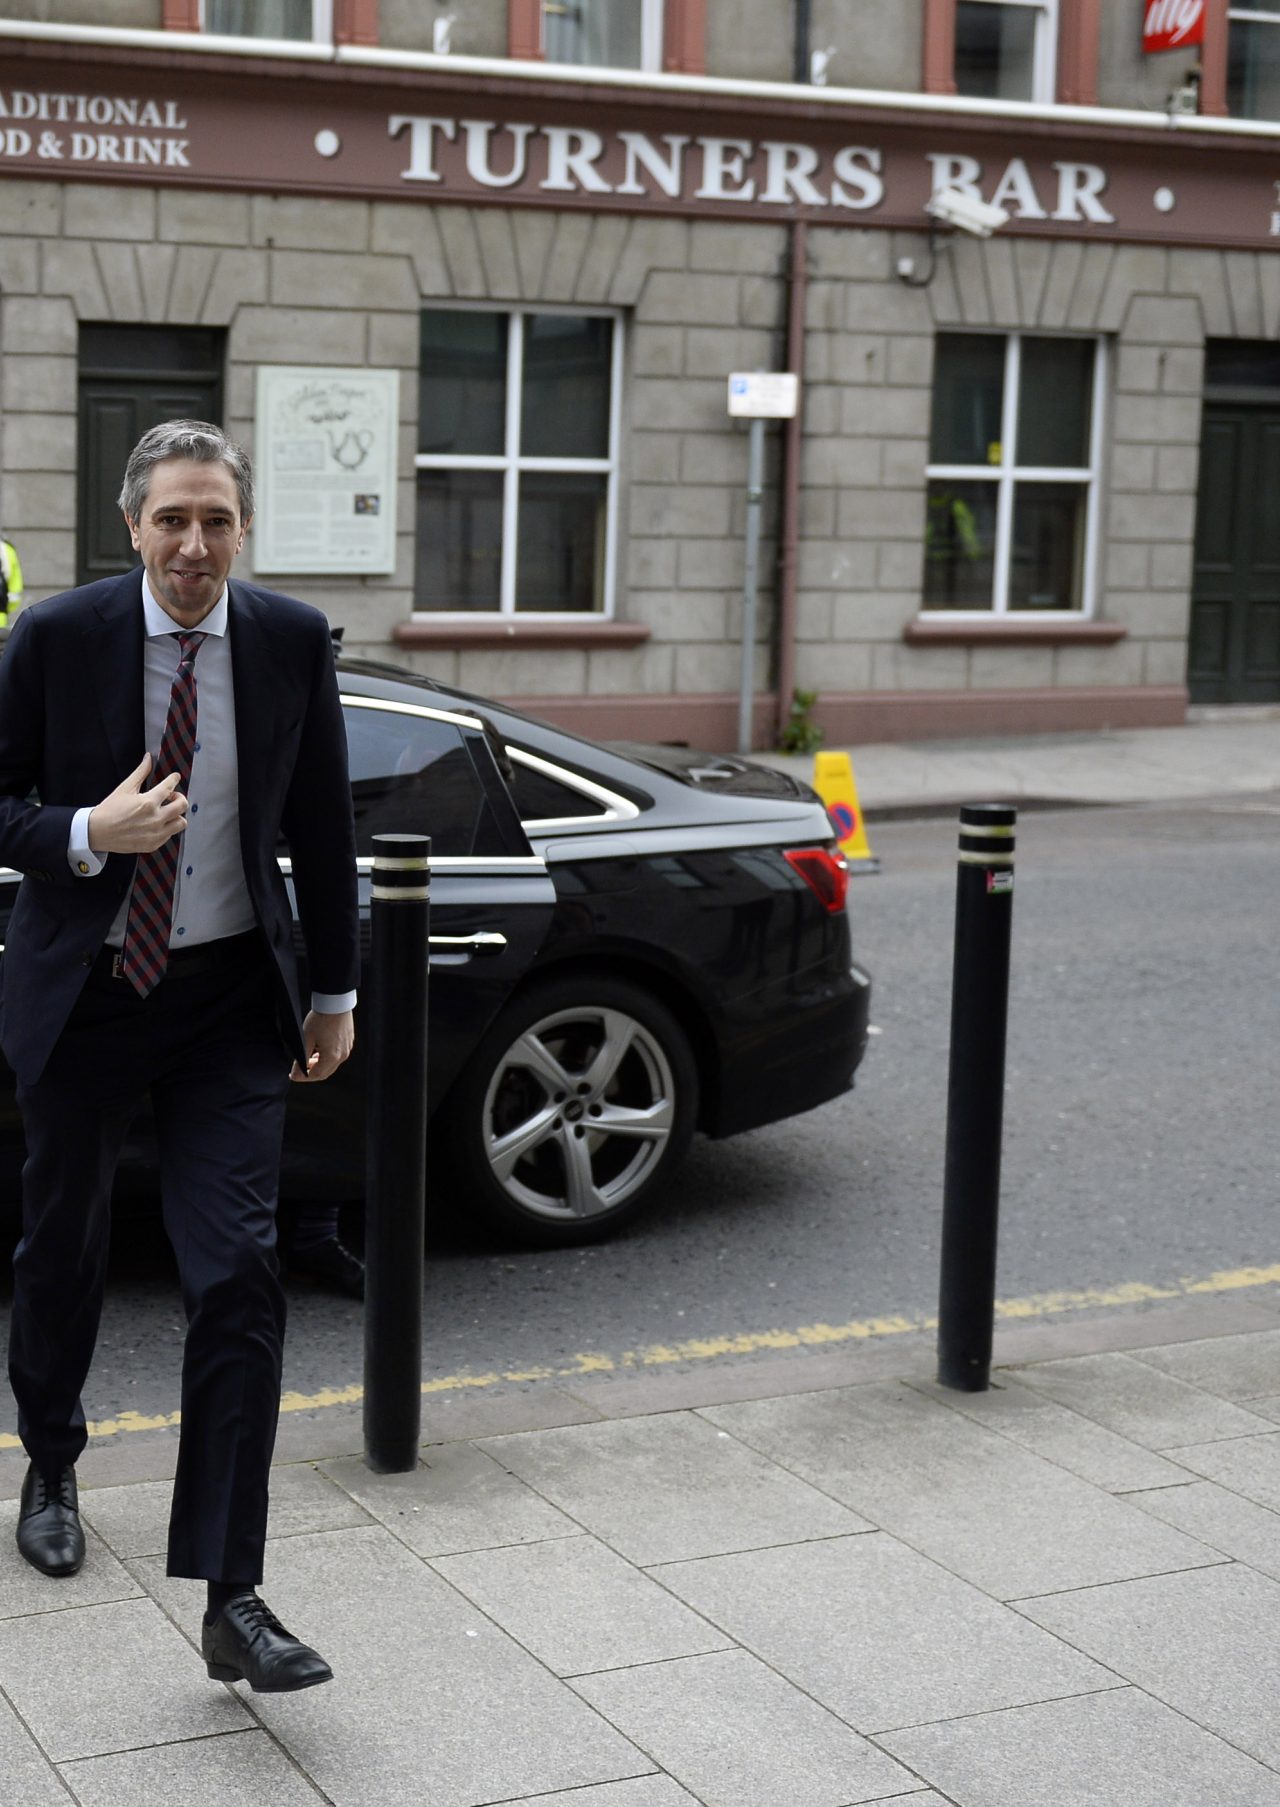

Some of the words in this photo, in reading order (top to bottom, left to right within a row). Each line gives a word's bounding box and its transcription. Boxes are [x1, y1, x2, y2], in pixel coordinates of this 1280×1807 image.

[37, 130, 64, 159] &
[71, 132, 191, 167] DRINK
[388, 114, 885, 210] TURNERS
[926, 152, 1116, 223] BAR
